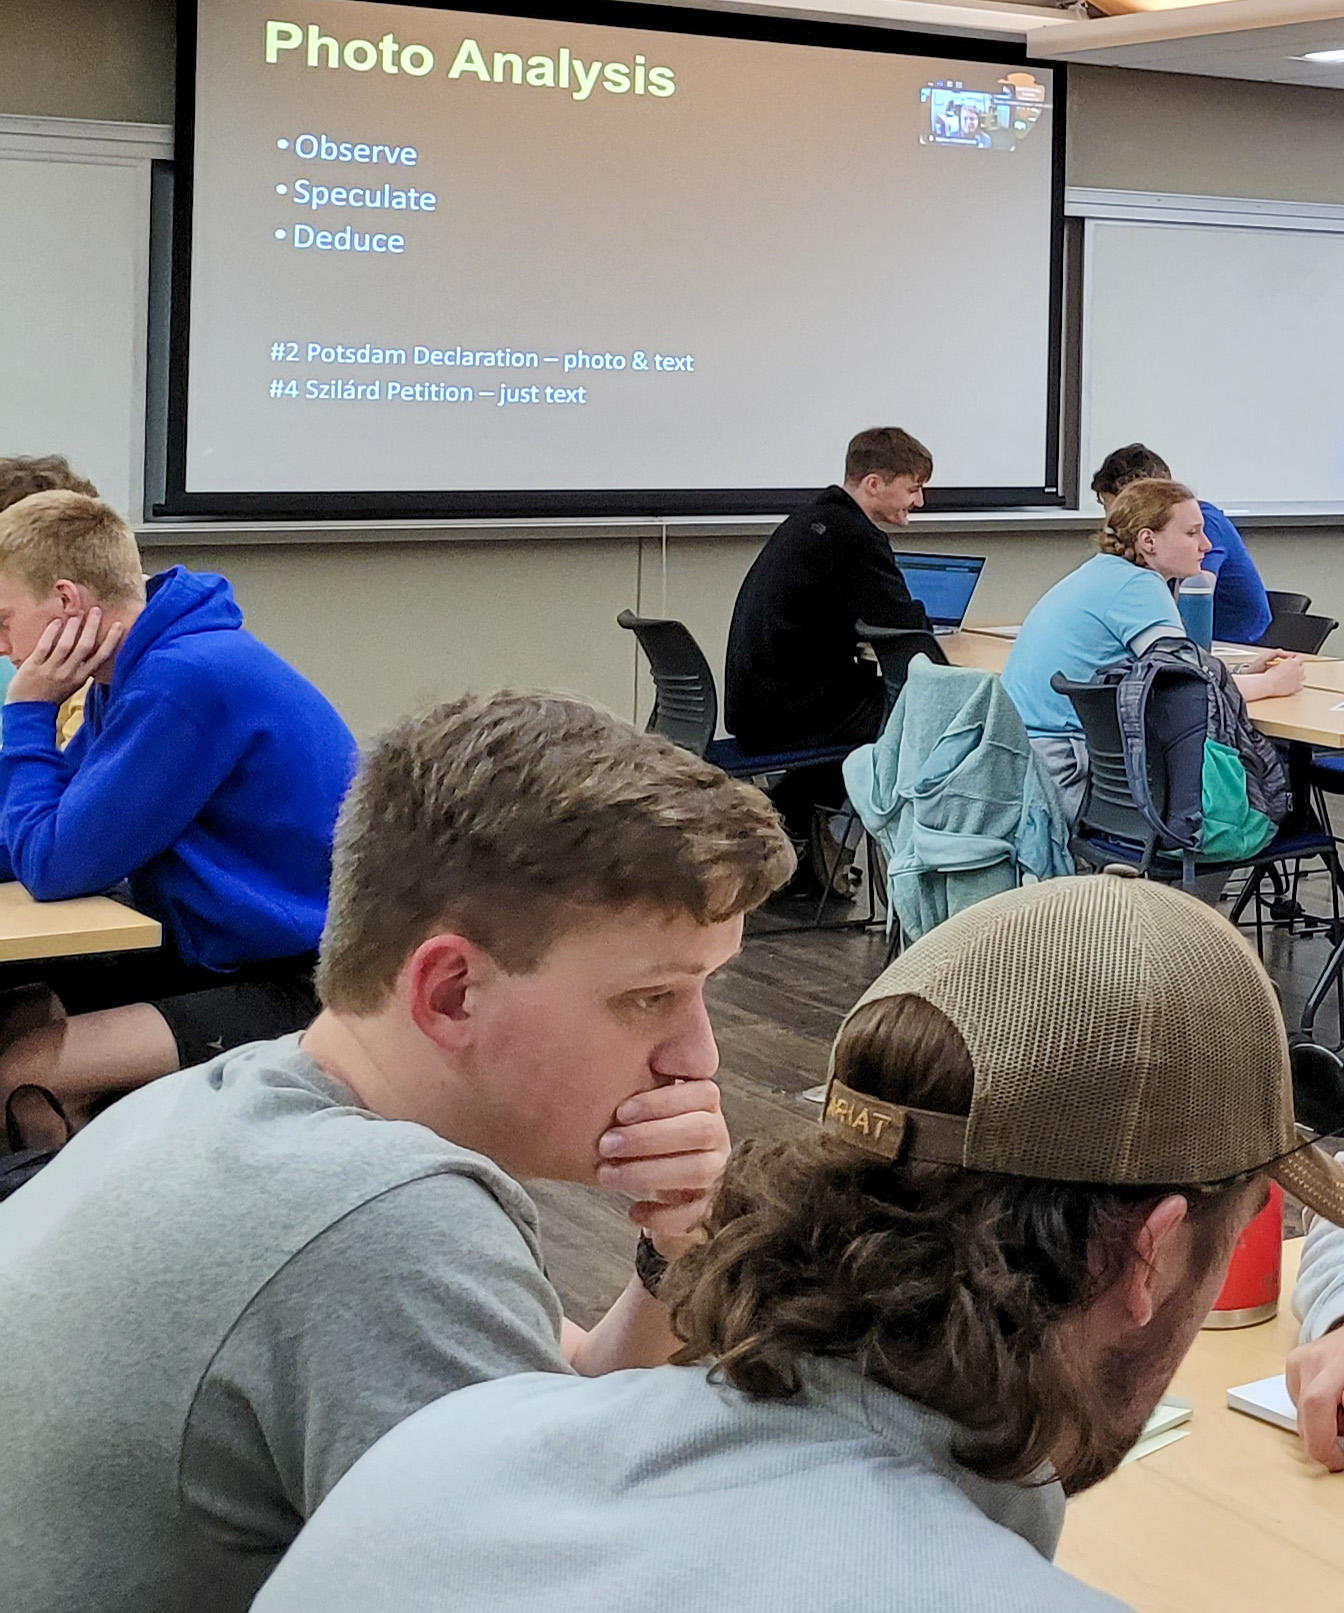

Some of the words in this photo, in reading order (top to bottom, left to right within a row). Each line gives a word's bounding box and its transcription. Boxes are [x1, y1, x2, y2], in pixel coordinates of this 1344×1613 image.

[264, 20, 435, 77] Photo
[448, 38, 677, 101] Analysis
[295, 133, 418, 166] Observe
[293, 178, 438, 212] Speculate
[293, 223, 405, 254] Deduce
[270, 341, 300, 362] #2
[307, 343, 406, 365] Potsdam
[413, 346, 539, 368] Declaration
[563, 349, 626, 373] photo
[631, 351, 649, 371] &
[654, 353, 695, 372] text
[269, 379, 300, 398] #4
[305, 378, 380, 400] Szilárd
[387, 381, 474, 401] Petition
[496, 383, 540, 406] just
[545, 385, 587, 403] text
